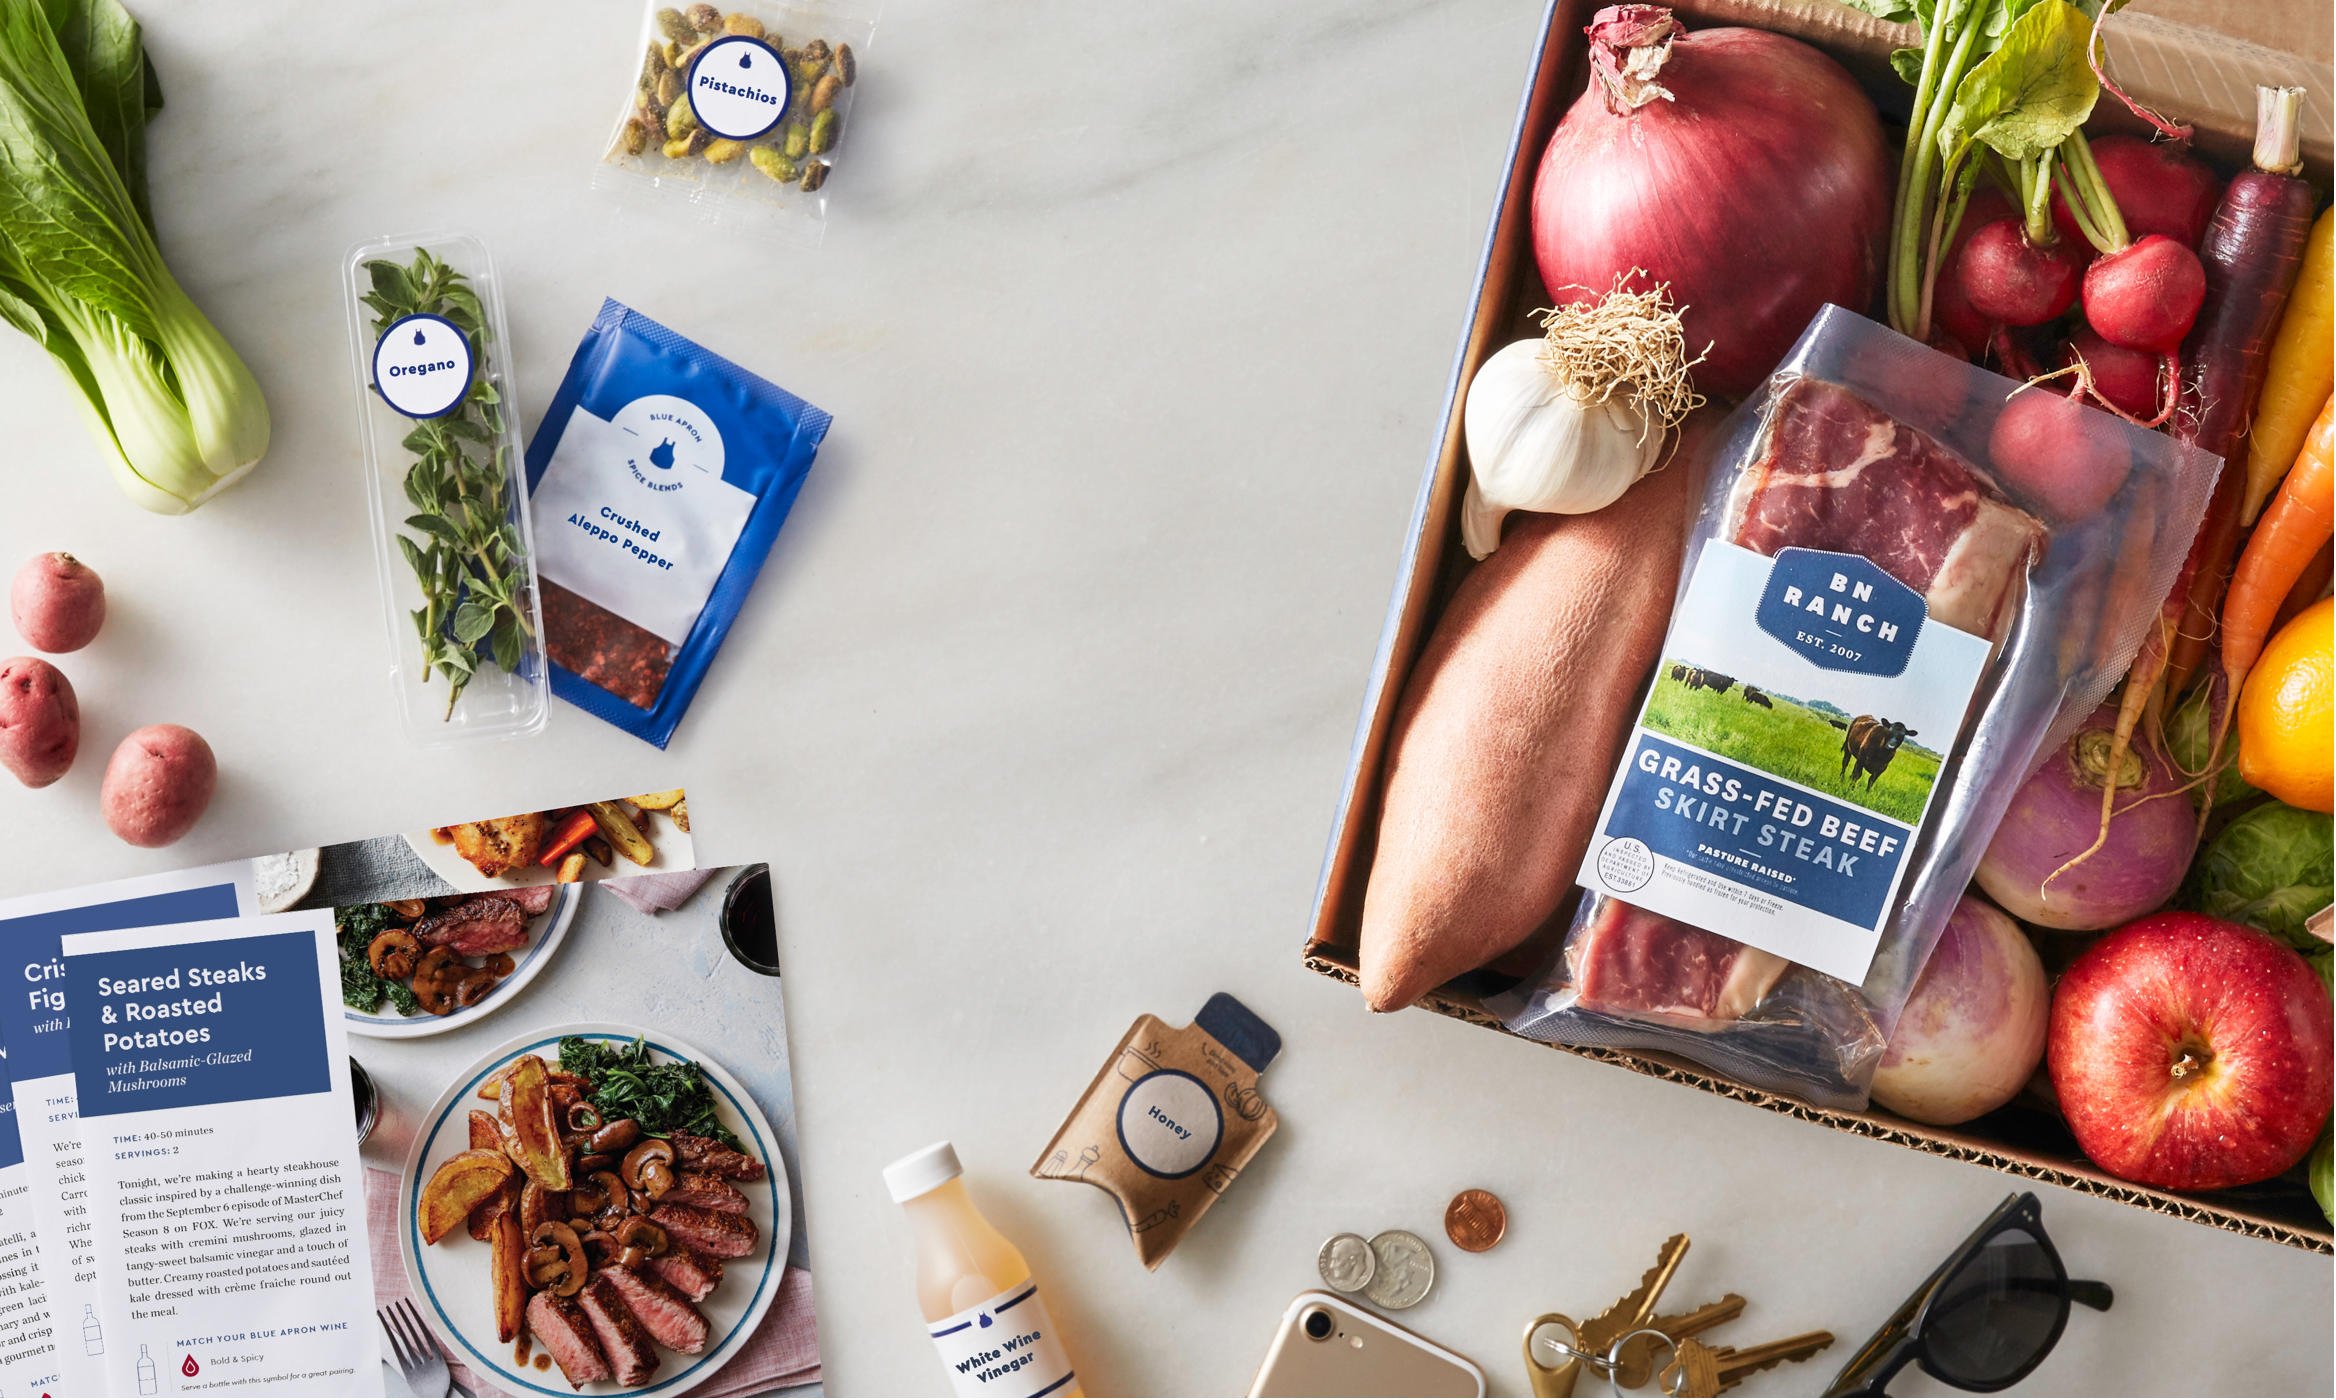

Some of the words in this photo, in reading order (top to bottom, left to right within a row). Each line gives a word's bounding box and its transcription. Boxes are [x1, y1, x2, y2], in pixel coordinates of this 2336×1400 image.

[699, 75, 778, 106] Pistachios
[389, 358, 456, 377] Oregano
[650, 413, 673, 421] BLUE
[676, 418, 702, 443] APRON
[627, 459, 646, 484] SPICE
[647, 481, 683, 492] BLENDS
[600, 506, 661, 543] Crushed
[567, 512, 619, 545] Aleppo
[622, 538, 674, 571] Pepper
[1829, 572, 1874, 604] BN
[1783, 585, 1900, 643] RANCH
[1795, 630, 1824, 652] EST.
[1829, 640, 1863, 664] 2007
[1637, 749, 1813, 827] GRASS-FED
[1820, 818, 1899, 858] BEEF
[1654, 785, 1749, 838] SKIRT
[1757, 823, 1861, 879] STEAK
[1698, 843, 1748, 868] PASTURE
[99, 968, 180, 996] Seared
[189, 961, 266, 986] Steaks
[102, 1005, 118, 1024] &
[126, 992, 222, 1021] Roasted
[34, 1018, 62, 1033] with
[104, 1028, 210, 1052] Potatoes
[106, 1062, 135, 1076] with
[139, 1049, 252, 1072] Balsamic-Glazed
[108, 1077, 186, 1093] Mushrooms
[45, 1096, 73, 1106] TIME:
[113, 1135, 141, 1143] TIME:
[144, 1131, 172, 1140] 40-50
[175, 1128, 214, 1137] minutes
[1148, 1105, 1192, 1141] Honey
[56, 1158, 84, 1168] seaso
[115, 1148, 170, 1160] SERVINGS:
[173, 1146, 179, 1154] 2
[117, 1178, 160, 1189] Tonight,
[165, 1174, 191, 1184] we're
[196, 1171, 233, 1181] making
[247, 1165, 279, 1176] hearty
[284, 1160, 339, 1172] steakhouse
[120, 1195, 152, 1205] classic
[156, 1189, 197, 1202] inspired
[200, 1188, 212, 1199] by
[224, 1178, 317, 1194] challenge-winning
[320, 1174, 341, 1184] dish
[121, 1213, 146, 1222] from
[148, 1210, 164, 1219] the
[166, 1204, 221, 1218] September
[223, 1203, 229, 1211] 6
[231, 1199, 269, 1212] episode
[272, 1196, 282, 1206] of
[284, 1190, 343, 1204] MasterChef
[123, 1229, 158, 1238] Season
[163, 1226, 169, 1234] 8
[193, 1220, 218, 1230] FOX.
[223, 1217, 251, 1227] We're
[256, 1213, 294, 1224] serving
[298, 1212, 315, 1220] our
[320, 1208, 344, 1219] juicy
[125, 1243, 156, 1254] steaks
[161, 1240, 183, 1250] with
[233, 1231, 295, 1243] mushrooms,
[300, 1224, 331, 1238] glazed
[336, 1223, 346, 1231] in
[127, 1257, 187, 1271] tangy-sweet
[190, 1252, 234, 1264] balsamic
[237, 1249, 274, 1259] vinegar
[277, 1244, 295, 1254] and
[307, 1241, 335, 1251] touch
[338, 1239, 348, 1248] of
[128, 1277, 162, 1287] butter.
[164, 1273, 203, 1283] Creamy
[206, 1266, 243, 1278] roasted
[246, 1264, 289, 1276] potatoes
[291, 1259, 309, 1269] and
[130, 1293, 150, 1303] kale
[155, 1288, 193, 1300] dressed
[198, 1286, 220, 1295] with
[300, 1273, 330, 1285] round
[335, 1272, 351, 1280] out
[132, 1310, 148, 1319] the
[151, 1306, 178, 1317] meal.
[177, 1337, 213, 1347] MATCH
[217, 1333, 245, 1342] YOUR
[250, 1330, 275, 1339] BLUE
[281, 1326, 316, 1336] APRON
[320, 1322, 347, 1331] WINE
[211, 1356, 230, 1365] Bold
[241, 1354, 264, 1363] Spicy
[955, 1350, 1001, 1374] White
[1002, 1330, 1041, 1353] Wine
[976, 1351, 1034, 1383] Vinegar
[31, 1375, 60, 1388] MATC
